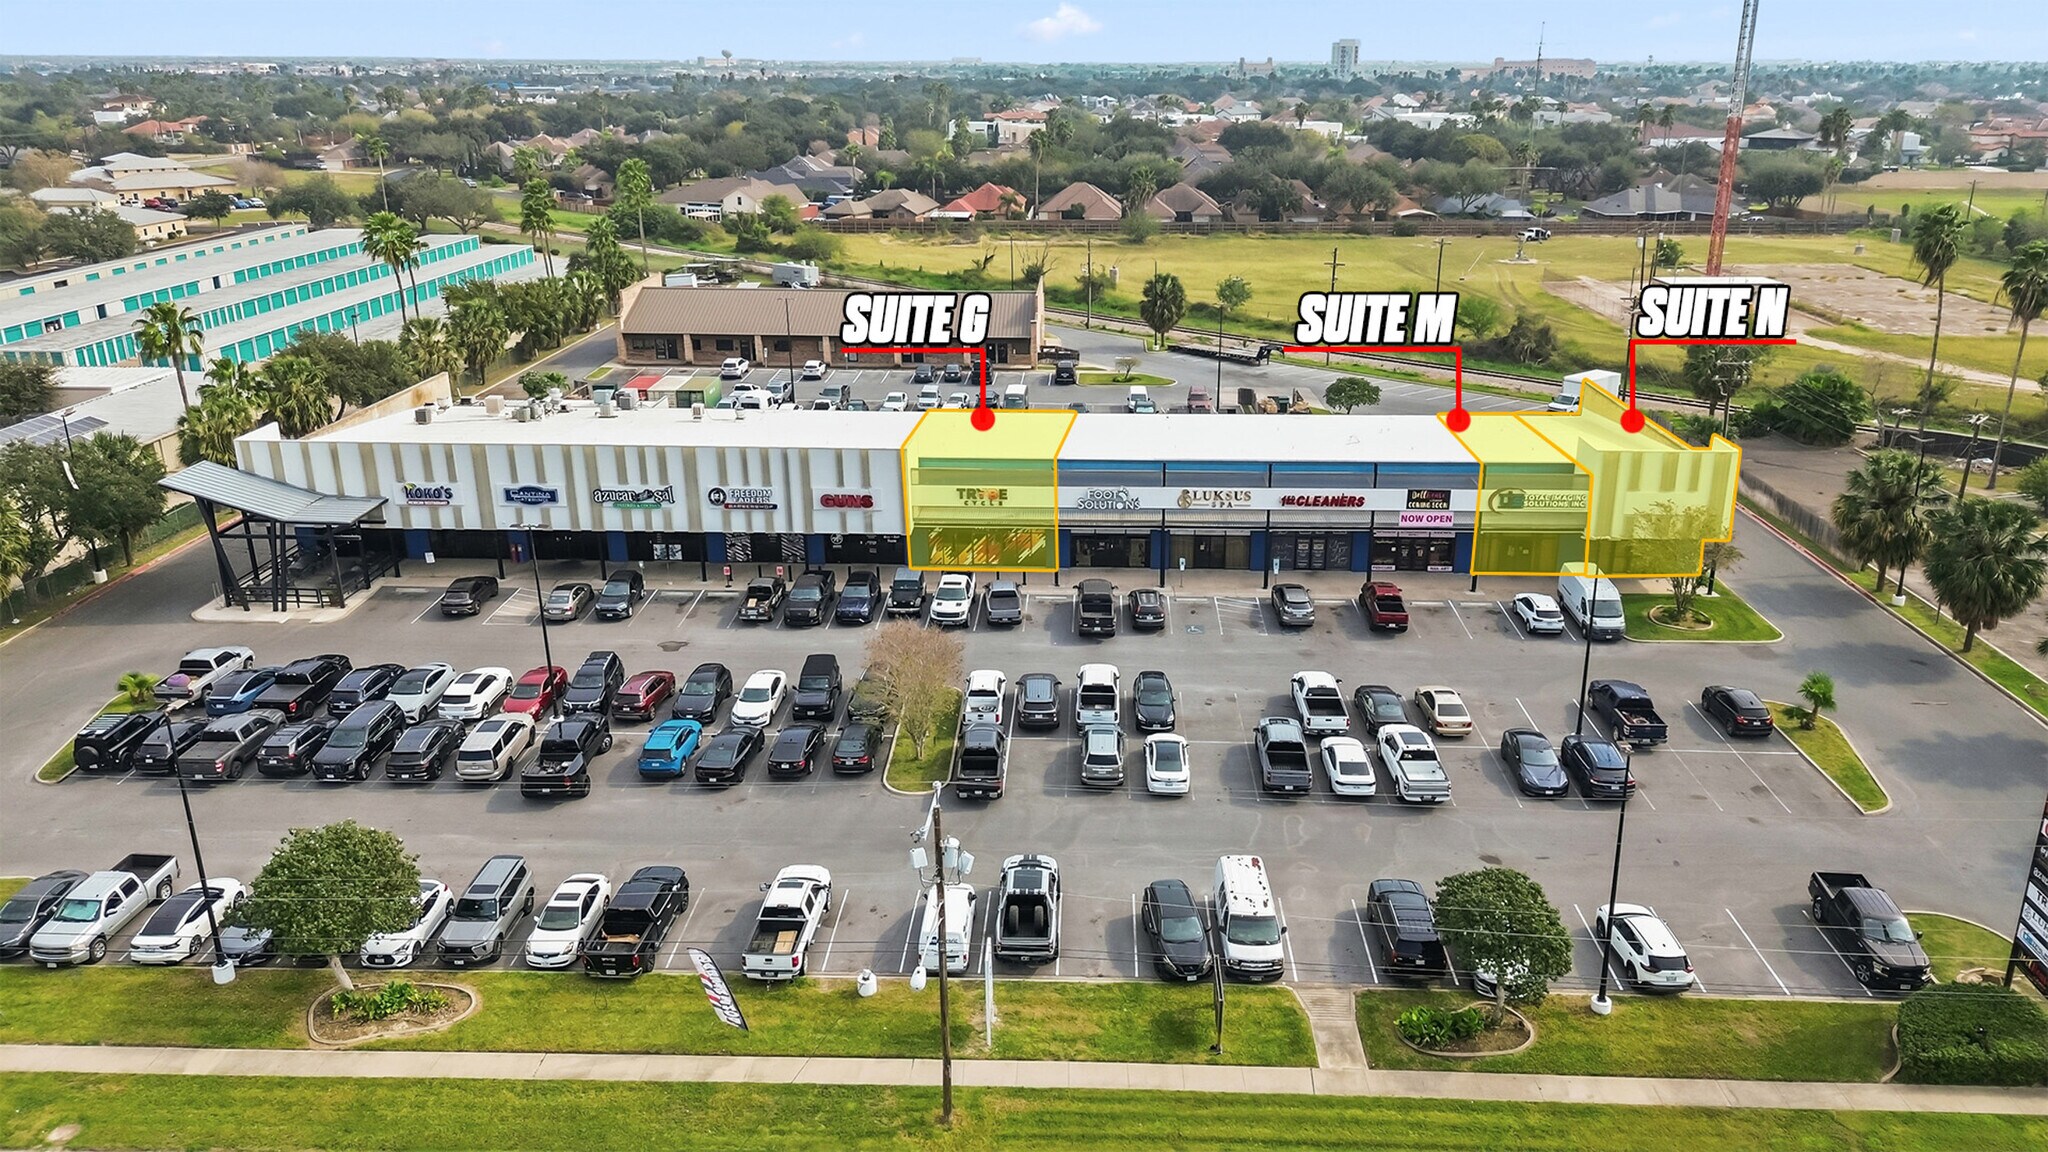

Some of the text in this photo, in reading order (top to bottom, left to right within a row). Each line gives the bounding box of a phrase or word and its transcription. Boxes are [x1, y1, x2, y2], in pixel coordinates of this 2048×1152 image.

[404, 486, 453, 499] KOKO'S
[593, 489, 636, 503] azucar
[654, 485, 675, 503] sal
[729, 489, 772, 497] FREEDOM
[1087, 490, 1118, 499] FOOT
[1193, 490, 1251, 501] LUKSUS
[820, 494, 873, 508] GUNS
[1077, 498, 1140, 510] SOLUTIONS
[1296, 495, 1365, 507] CLEANERS
